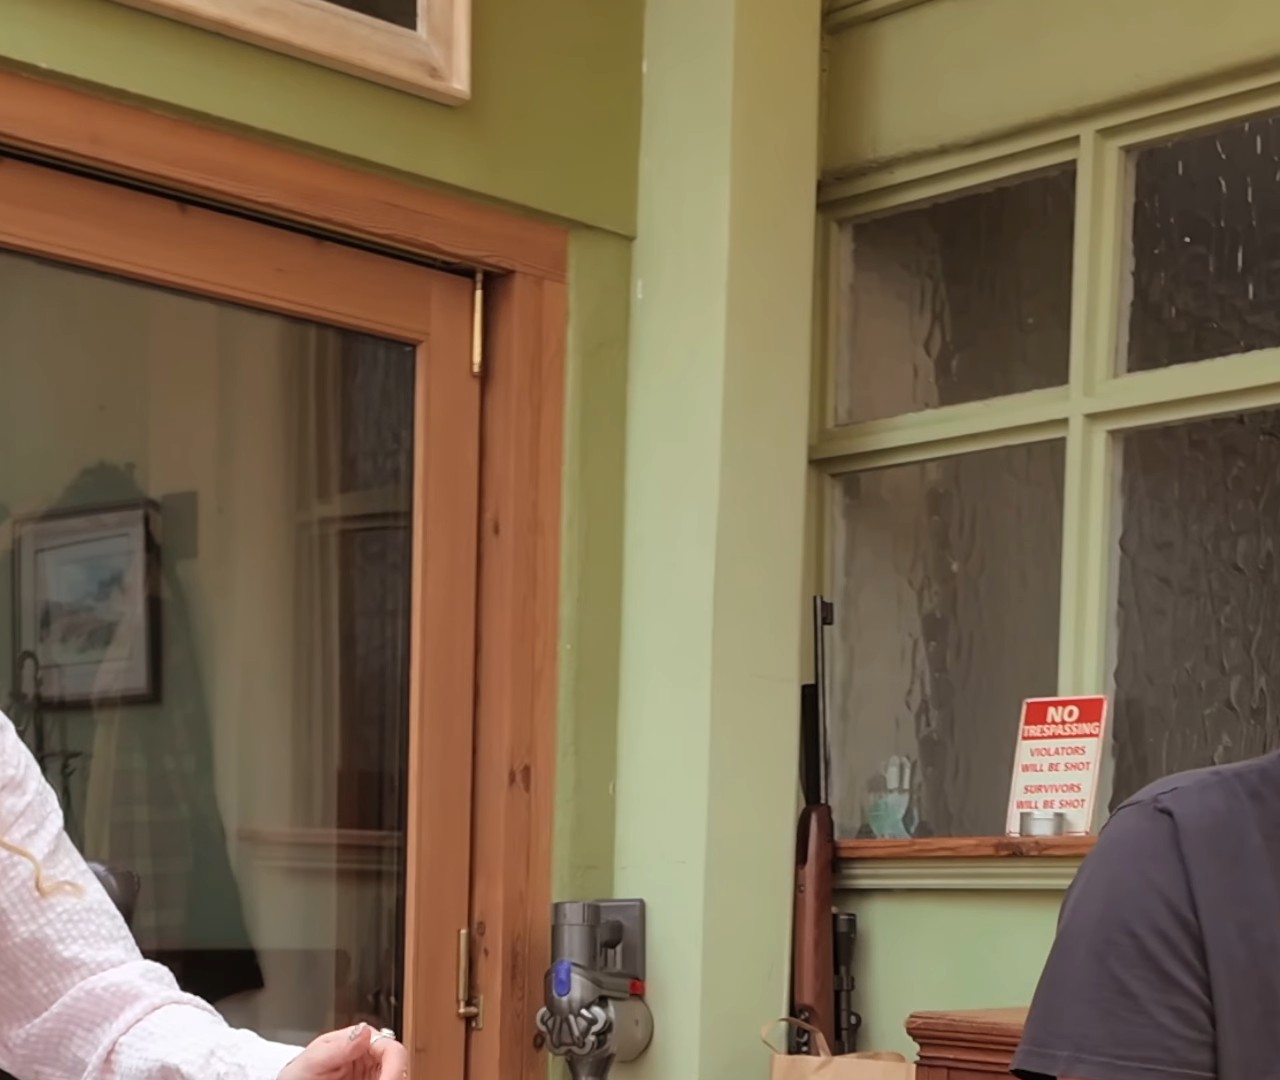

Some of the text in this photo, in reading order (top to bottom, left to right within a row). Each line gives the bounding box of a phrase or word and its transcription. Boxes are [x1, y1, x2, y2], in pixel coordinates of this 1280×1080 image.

[1046, 705, 1080, 723] NO
[1023, 722, 1100, 737] TRESPASSING
[1029, 746, 1086, 757] VIOLATORS
[1021, 761, 1091, 773] WILL BE SHOT
[1023, 783, 1082, 794] SURVIVORS
[1016, 799, 1086, 810] WILL BE SHOT
